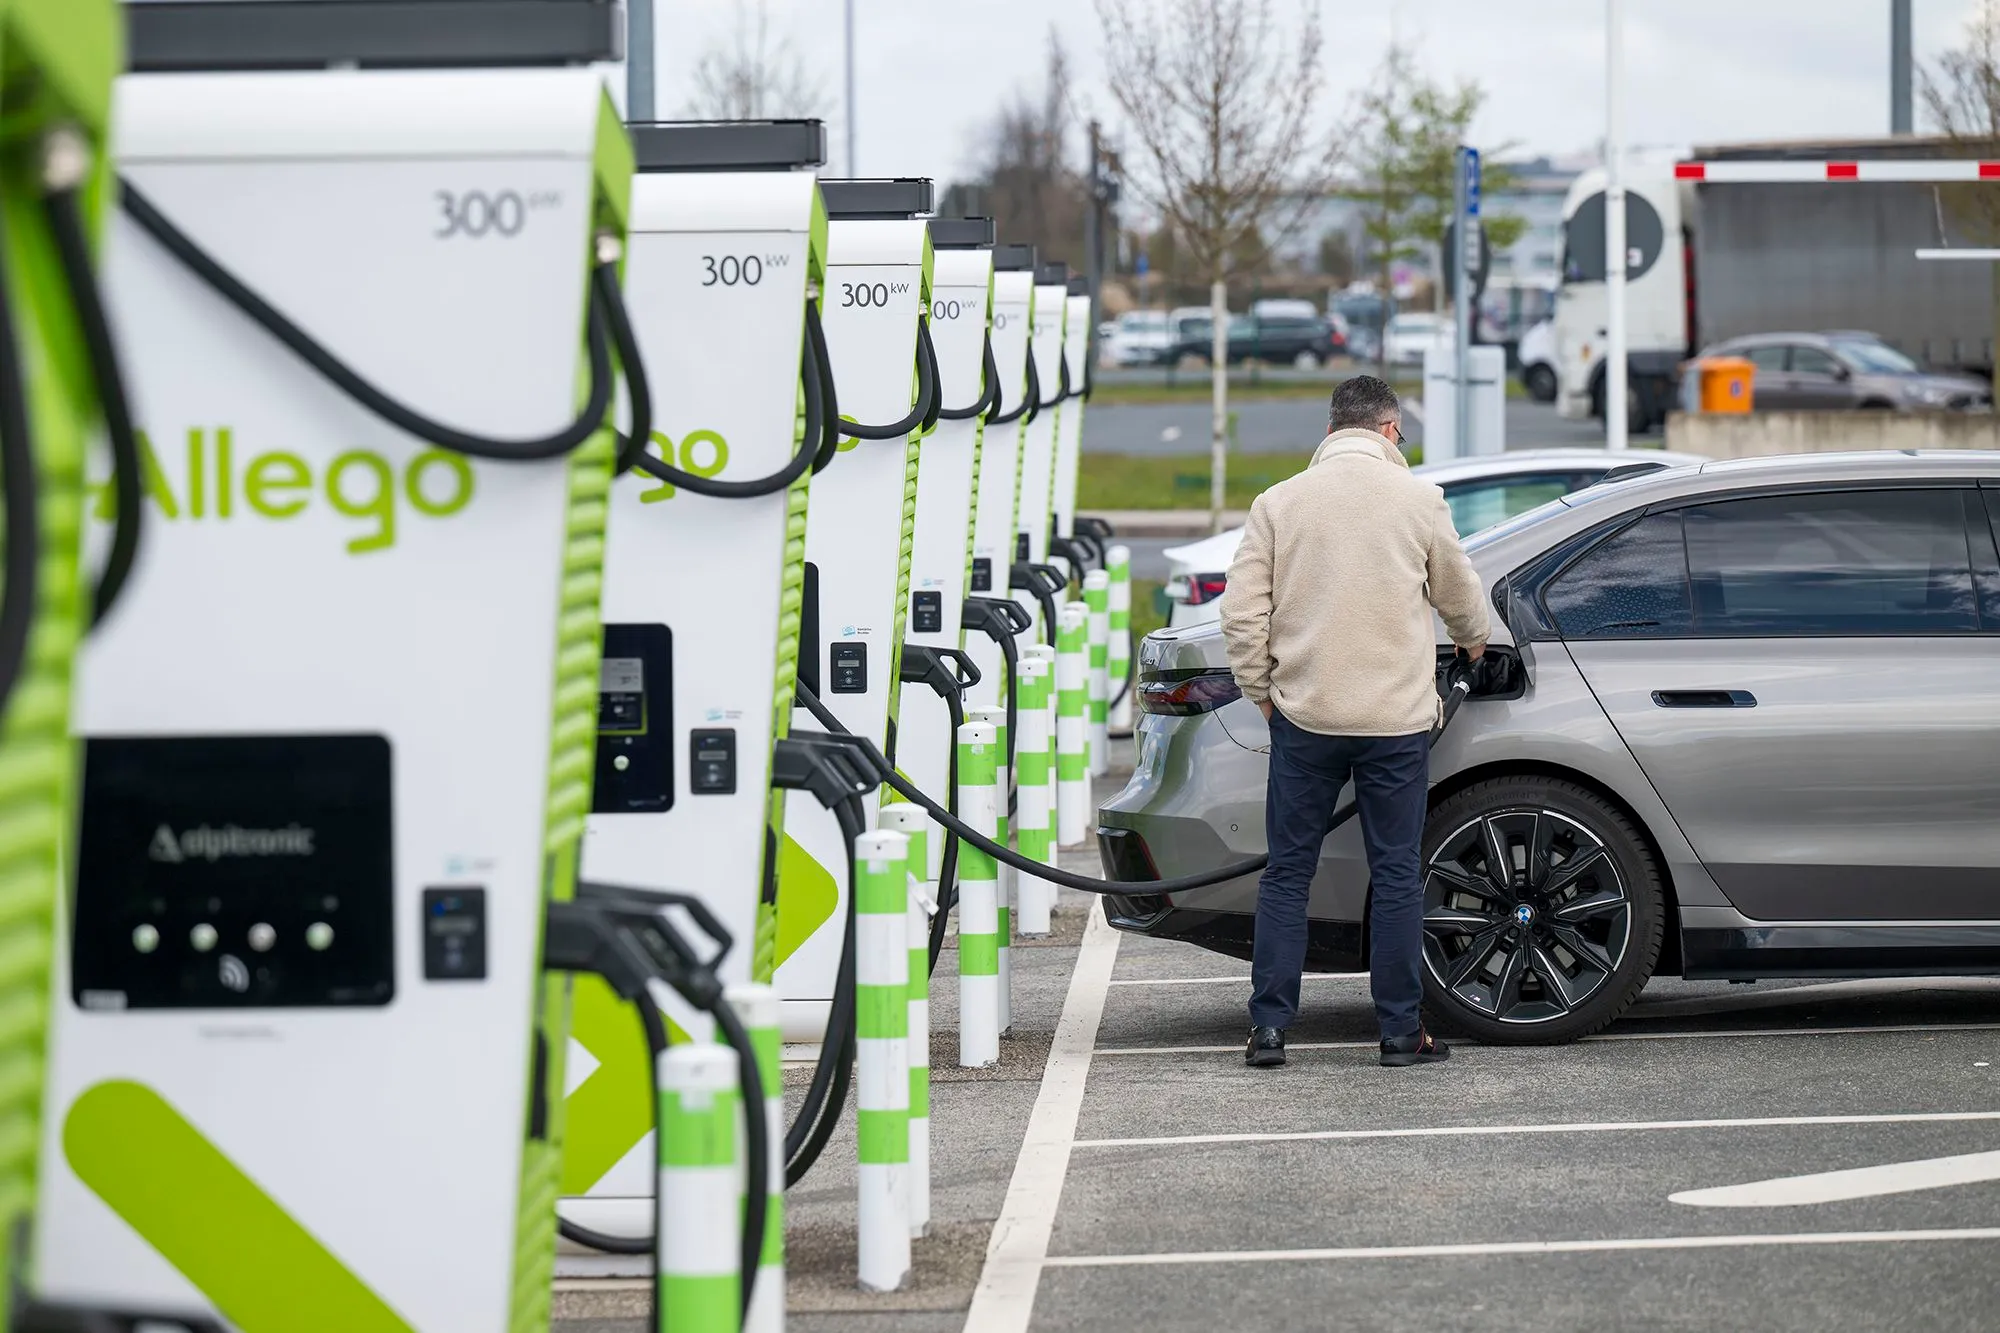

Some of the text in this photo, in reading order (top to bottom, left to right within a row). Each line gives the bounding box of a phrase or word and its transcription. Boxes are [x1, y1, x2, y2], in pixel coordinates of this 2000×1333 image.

[433, 189, 526, 238] 300
[702, 254, 789, 286] 300 kW
[841, 283, 909, 307] 300 kW
[930, 300, 960, 320] 00
